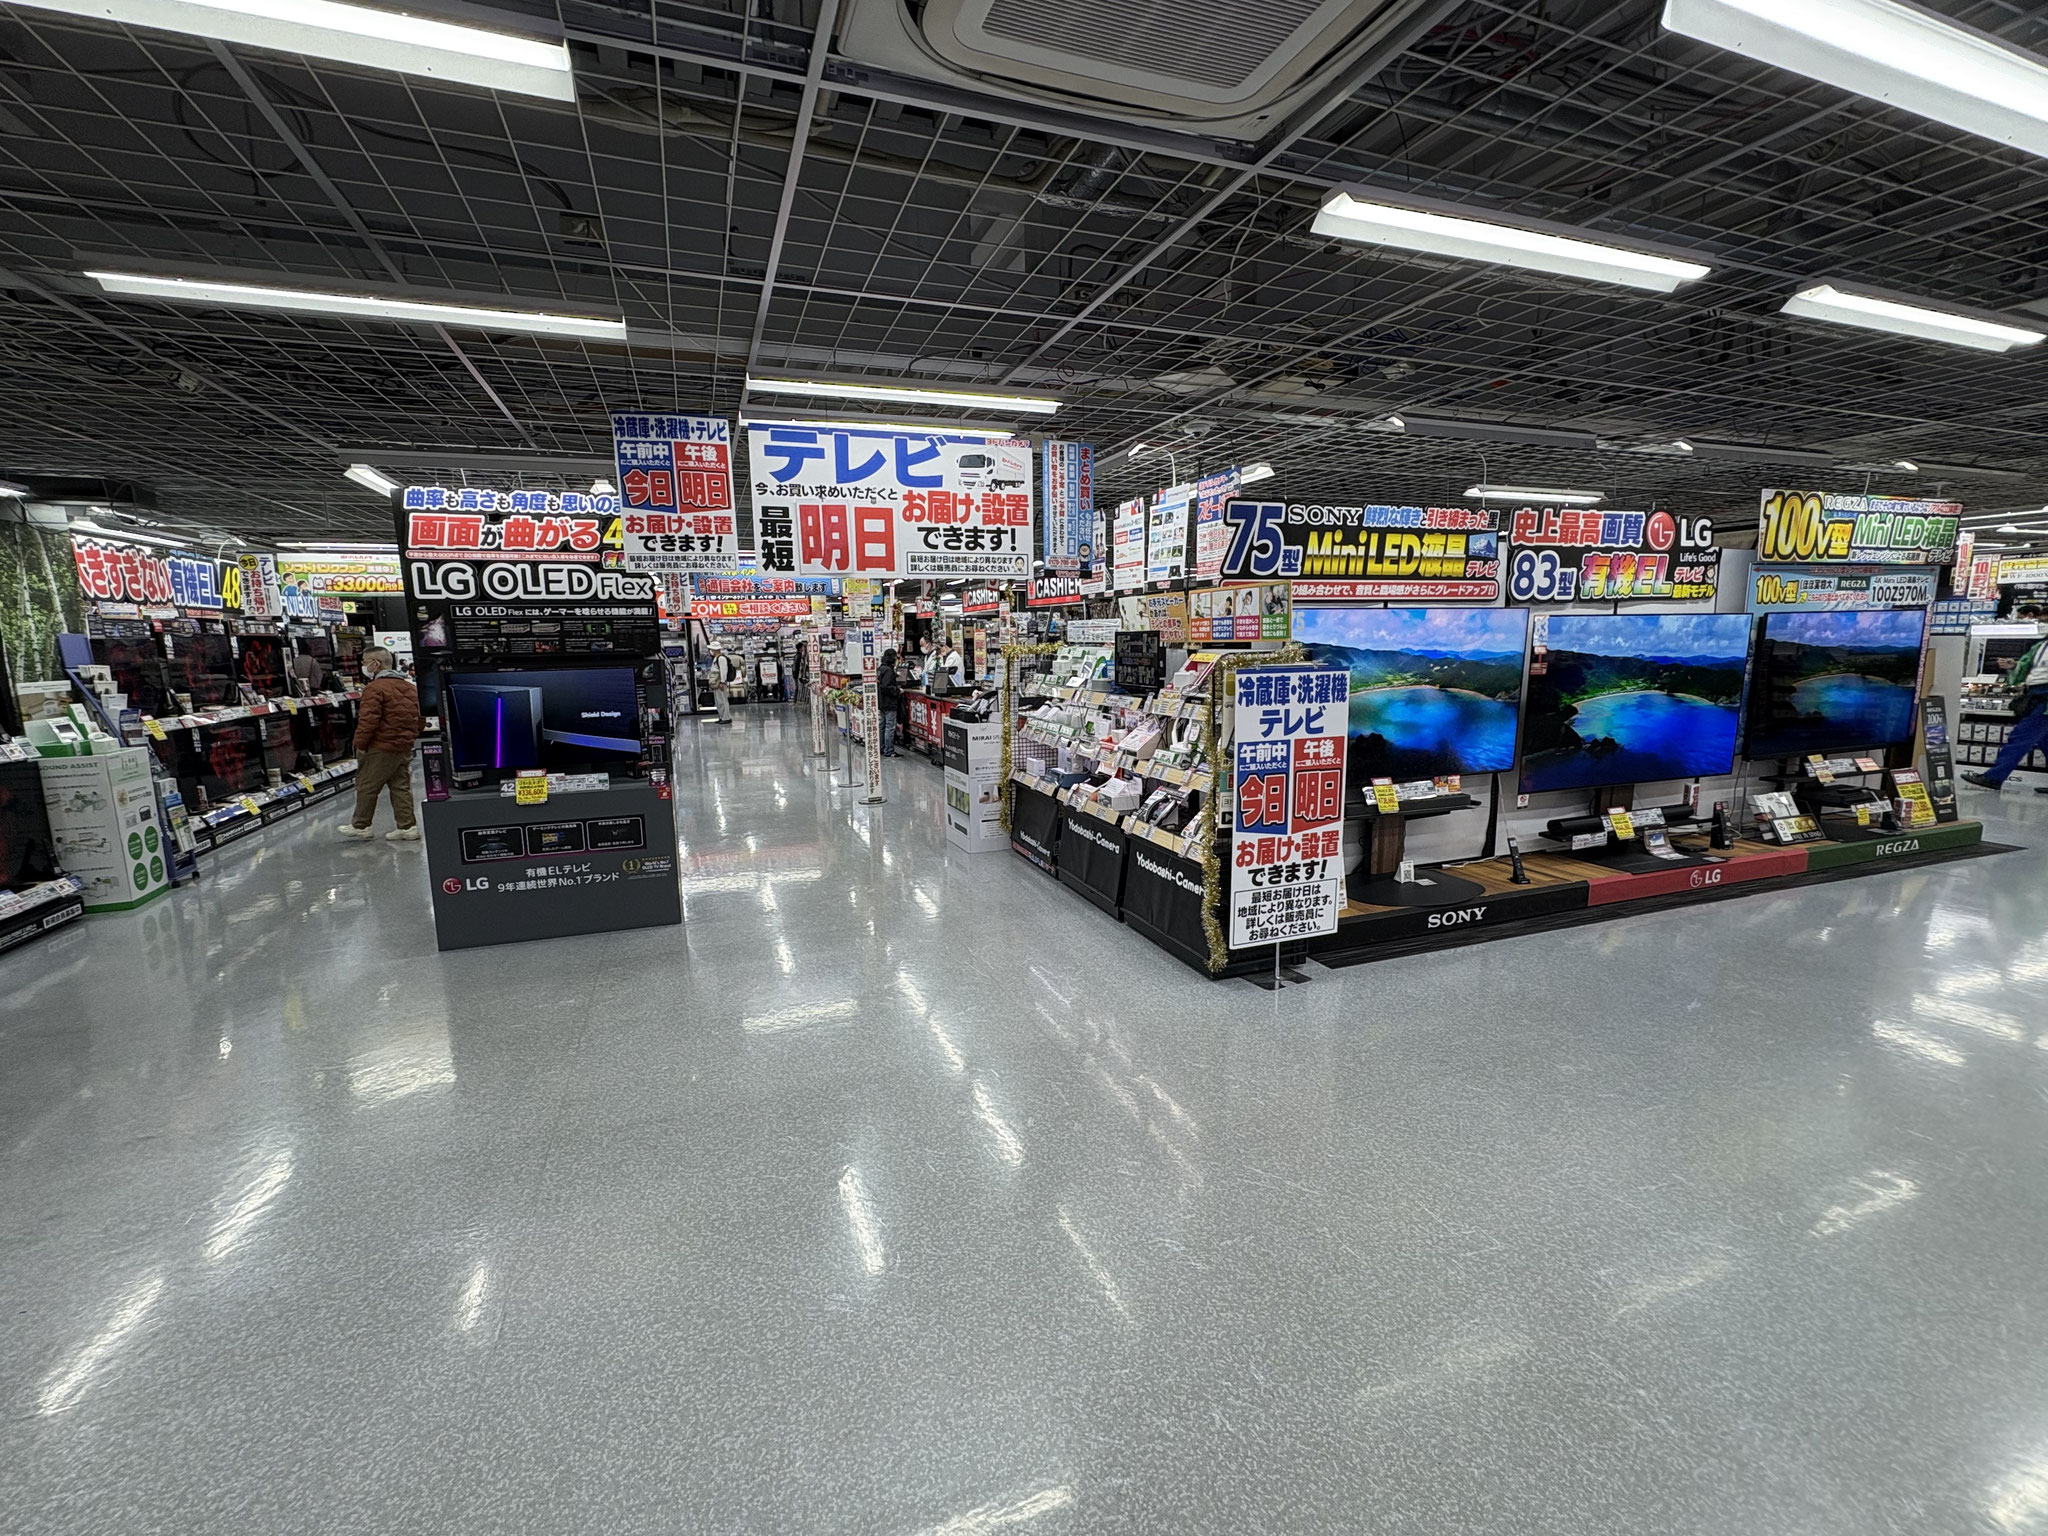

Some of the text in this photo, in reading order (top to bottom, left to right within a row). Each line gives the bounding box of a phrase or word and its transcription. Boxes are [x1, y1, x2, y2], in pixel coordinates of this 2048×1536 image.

[613, 416, 727, 441] 冷蔵庫・洗濯機・テレビ
[620, 442, 669, 459] 午前中
[684, 444, 717, 462] 午後
[763, 428, 948, 488] テレビ
[678, 461, 726, 469] にご購入いただくと
[623, 469, 673, 506] 今日
[680, 471, 728, 507] 明日
[1080, 448, 1091, 510] まとめ買い
[755, 482, 898, 500] 今、お買い求めいただくと
[902, 490, 1029, 527] お届け・設置
[1824, 496, 1868, 511] REGZA
[410, 515, 599, 549] 画面が曲がる
[625, 515, 733, 535] お届け・設置
[1512, 508, 1713, 547] 史上最高画質 LG
[759, 504, 896, 572] 最短 明日
[1226, 501, 1302, 573] 75型
[1289, 505, 1363, 525] SONY
[1363, 504, 1499, 530] 鮮烈な輝きと引き締まった黒
[1679, 553, 1716, 562] Life's Good
[1928, 549, 1953, 562] テレビ
[260, 557, 275, 586] テレビ
[1467, 561, 1500, 577] テレビ
[1513, 552, 1705, 599] 83型 有機EL テレビ
[169, 558, 222, 609] 有機EL
[222, 565, 241, 608] 48
[412, 563, 651, 599] LG OLED Flex
[926, 579, 934, 598] 2
[1840, 579, 1867, 588] REGZA
[1671, 584, 1716, 599] 最新モデル
[1871, 585, 1928, 602] 100Z970M
[456, 606, 471, 616] LG
[475, 606, 507, 616] OLED
[862, 630, 875, 656] 出口
[1237, 674, 1347, 708] 冷蔵庫・洗濯機
[581, 710, 621, 719] Shield Design
[1259, 706, 1327, 737] テレビ
[1239, 742, 1287, 764] 午前中
[1303, 739, 1334, 758] 午後
[1239, 761, 1287, 771] にご購入いただくと
[1295, 757, 1341, 767] にご購入いただくと
[501, 782, 515, 793] 42
[1295, 769, 1340, 823] 明日
[1239, 774, 1287, 828] 今日
[1068, 817, 1120, 855] Yodobashi-Camera
[1236, 830, 1339, 868] お届け・設置
[1876, 838, 1920, 857] REGZA
[525, 863, 591, 879] 有機ELテレビ
[1136, 851, 1207, 898] Yodobashi-Camer
[1705, 869, 1721, 885] LG
[466, 876, 489, 891] LG
[1251, 886, 1321, 905] 最短お届け日は
[1237, 898, 1333, 918] 地域により異なります。
[1427, 906, 1488, 929] SONY
[1246, 910, 1324, 929] 詳しくは販売員に
[1249, 924, 1321, 941] お尋ねください。
